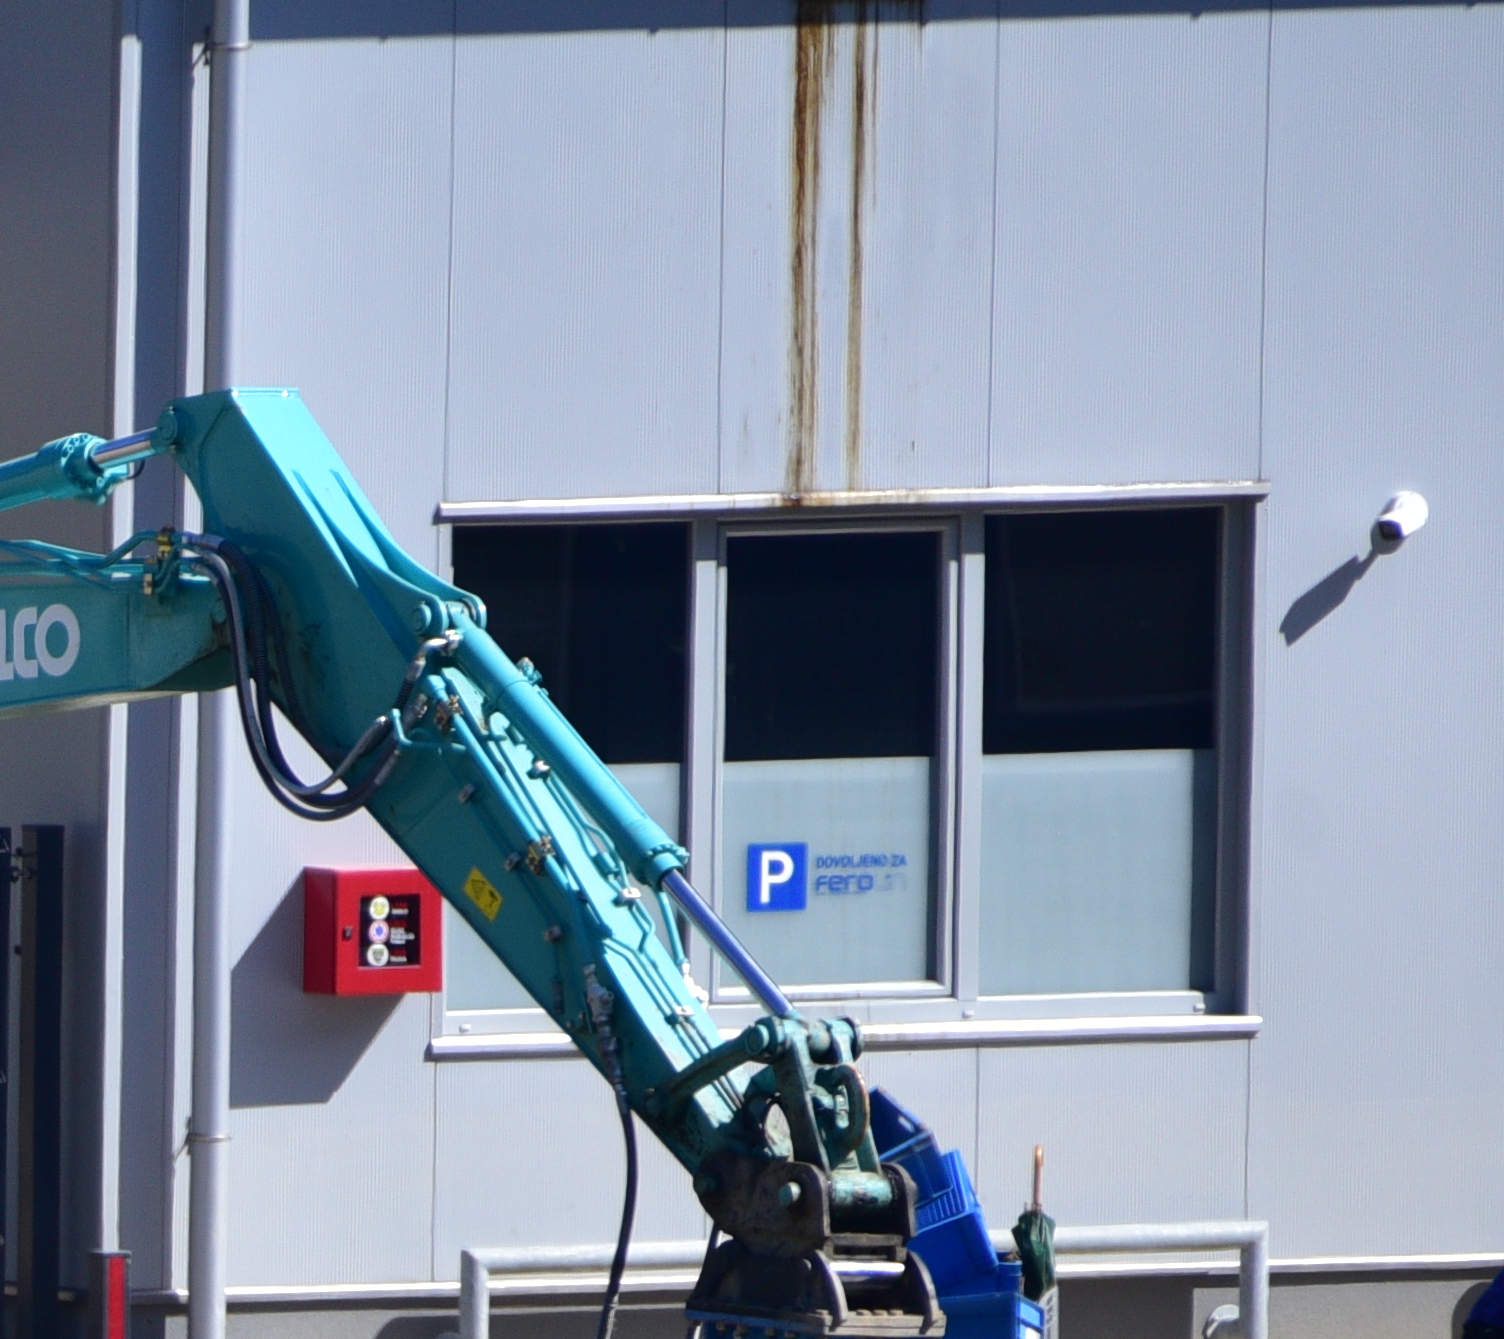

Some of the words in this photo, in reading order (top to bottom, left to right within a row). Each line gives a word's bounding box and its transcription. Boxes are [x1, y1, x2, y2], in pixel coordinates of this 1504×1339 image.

[760, 850, 794, 905] P
[815, 854, 886, 870] DOVOLJENO
[890, 854, 908, 868] ZA
